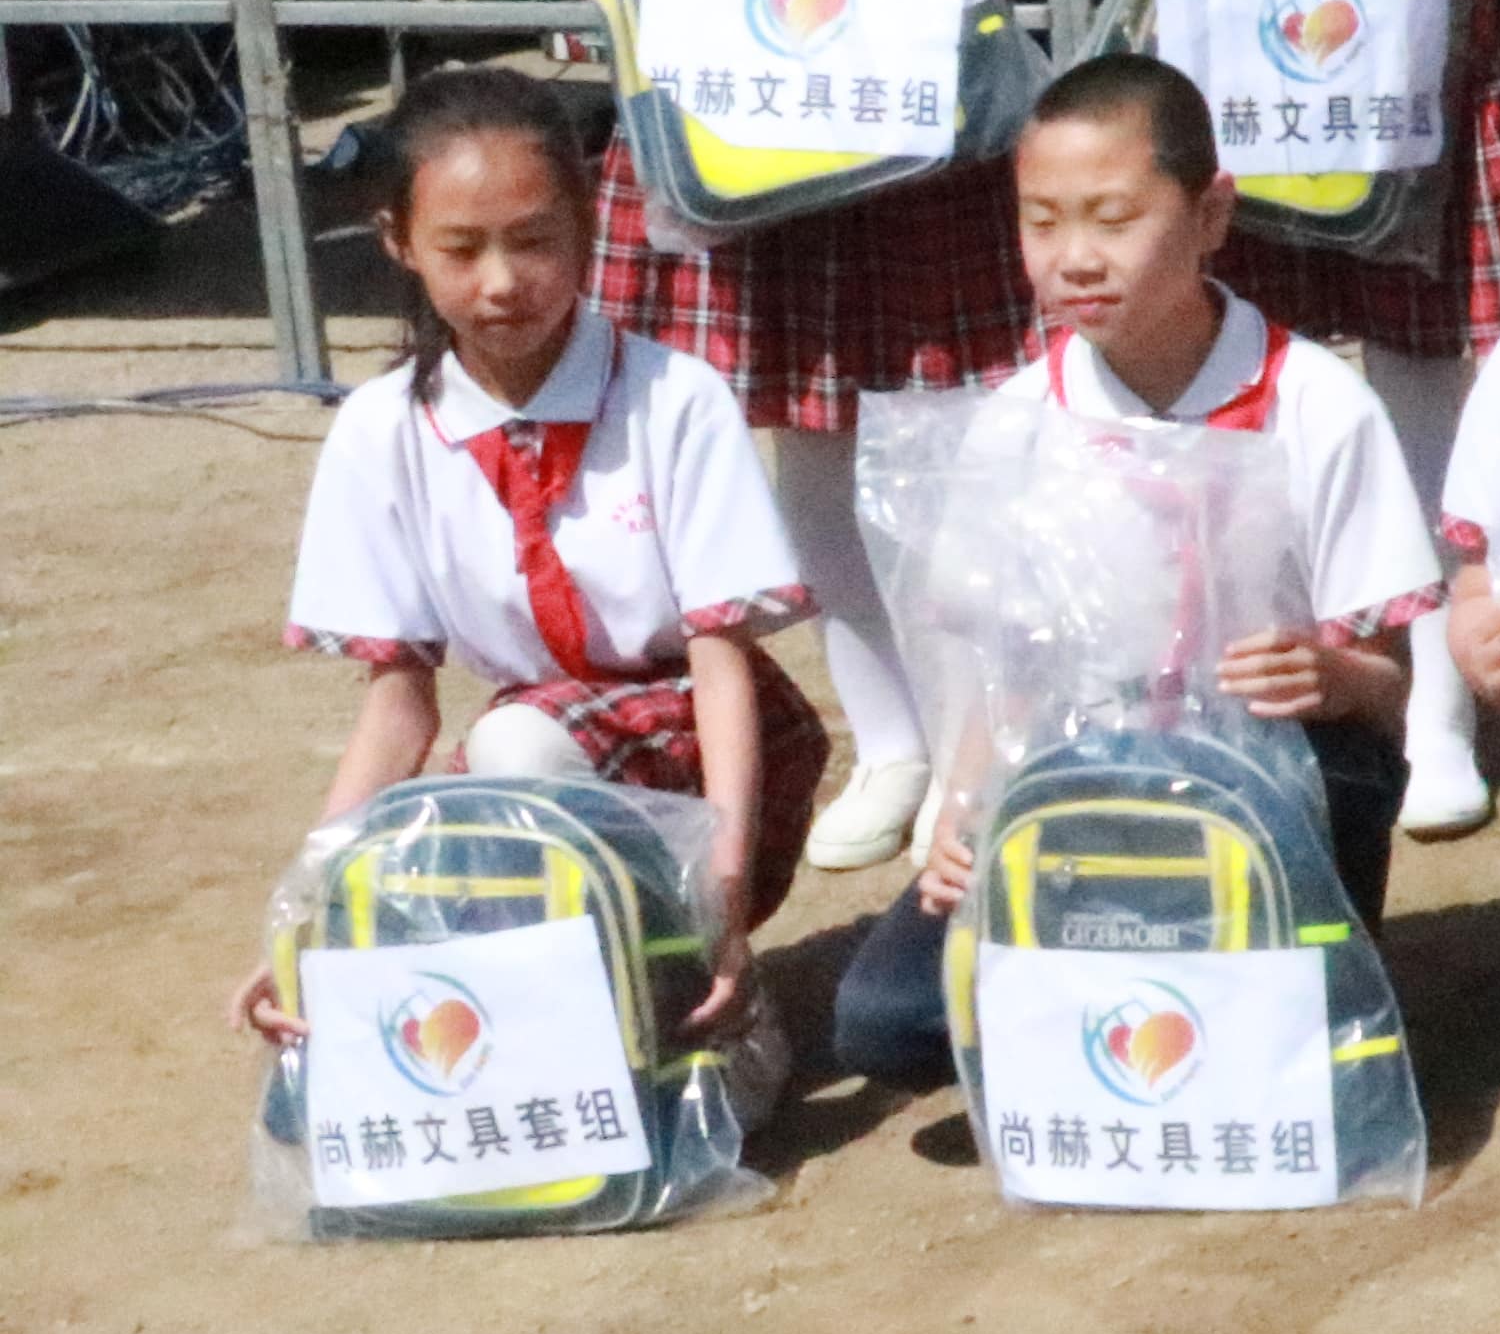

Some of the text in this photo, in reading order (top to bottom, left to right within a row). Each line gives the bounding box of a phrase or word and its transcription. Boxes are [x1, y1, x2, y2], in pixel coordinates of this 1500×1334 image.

[316, 1087, 629, 1173] 尚赫文具套组
[999, 1110, 1321, 1175] 尚赫文具套组
